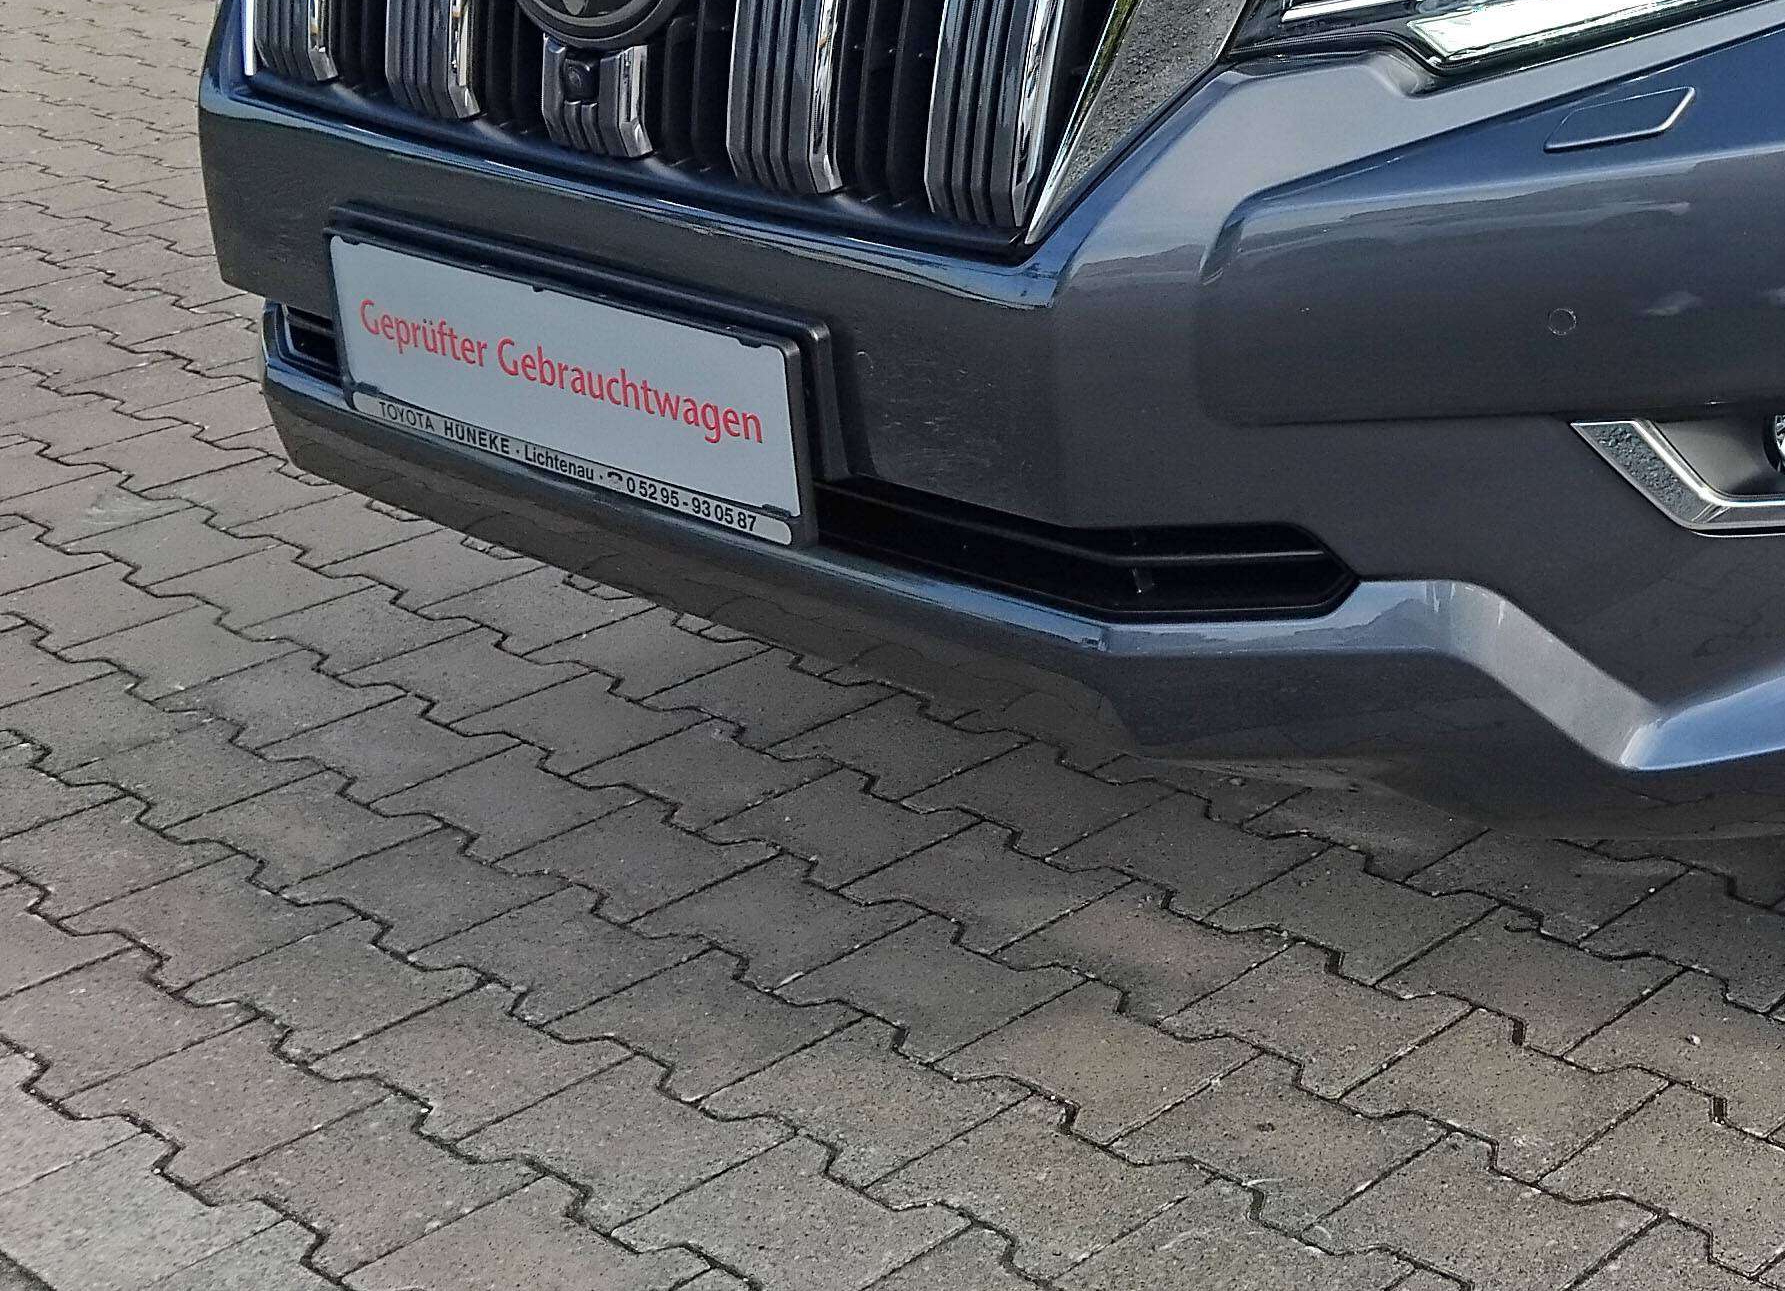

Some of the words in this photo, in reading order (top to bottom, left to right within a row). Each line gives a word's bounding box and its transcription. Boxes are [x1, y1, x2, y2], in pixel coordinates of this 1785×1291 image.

[358, 298, 488, 368] Geprüfter
[496, 337, 764, 445] Gebrauchtwagen
[378, 401, 435, 432] TOYOTA
[443, 419, 511, 455] HÜNEKE
[524, 444, 595, 481] Lichtenau
